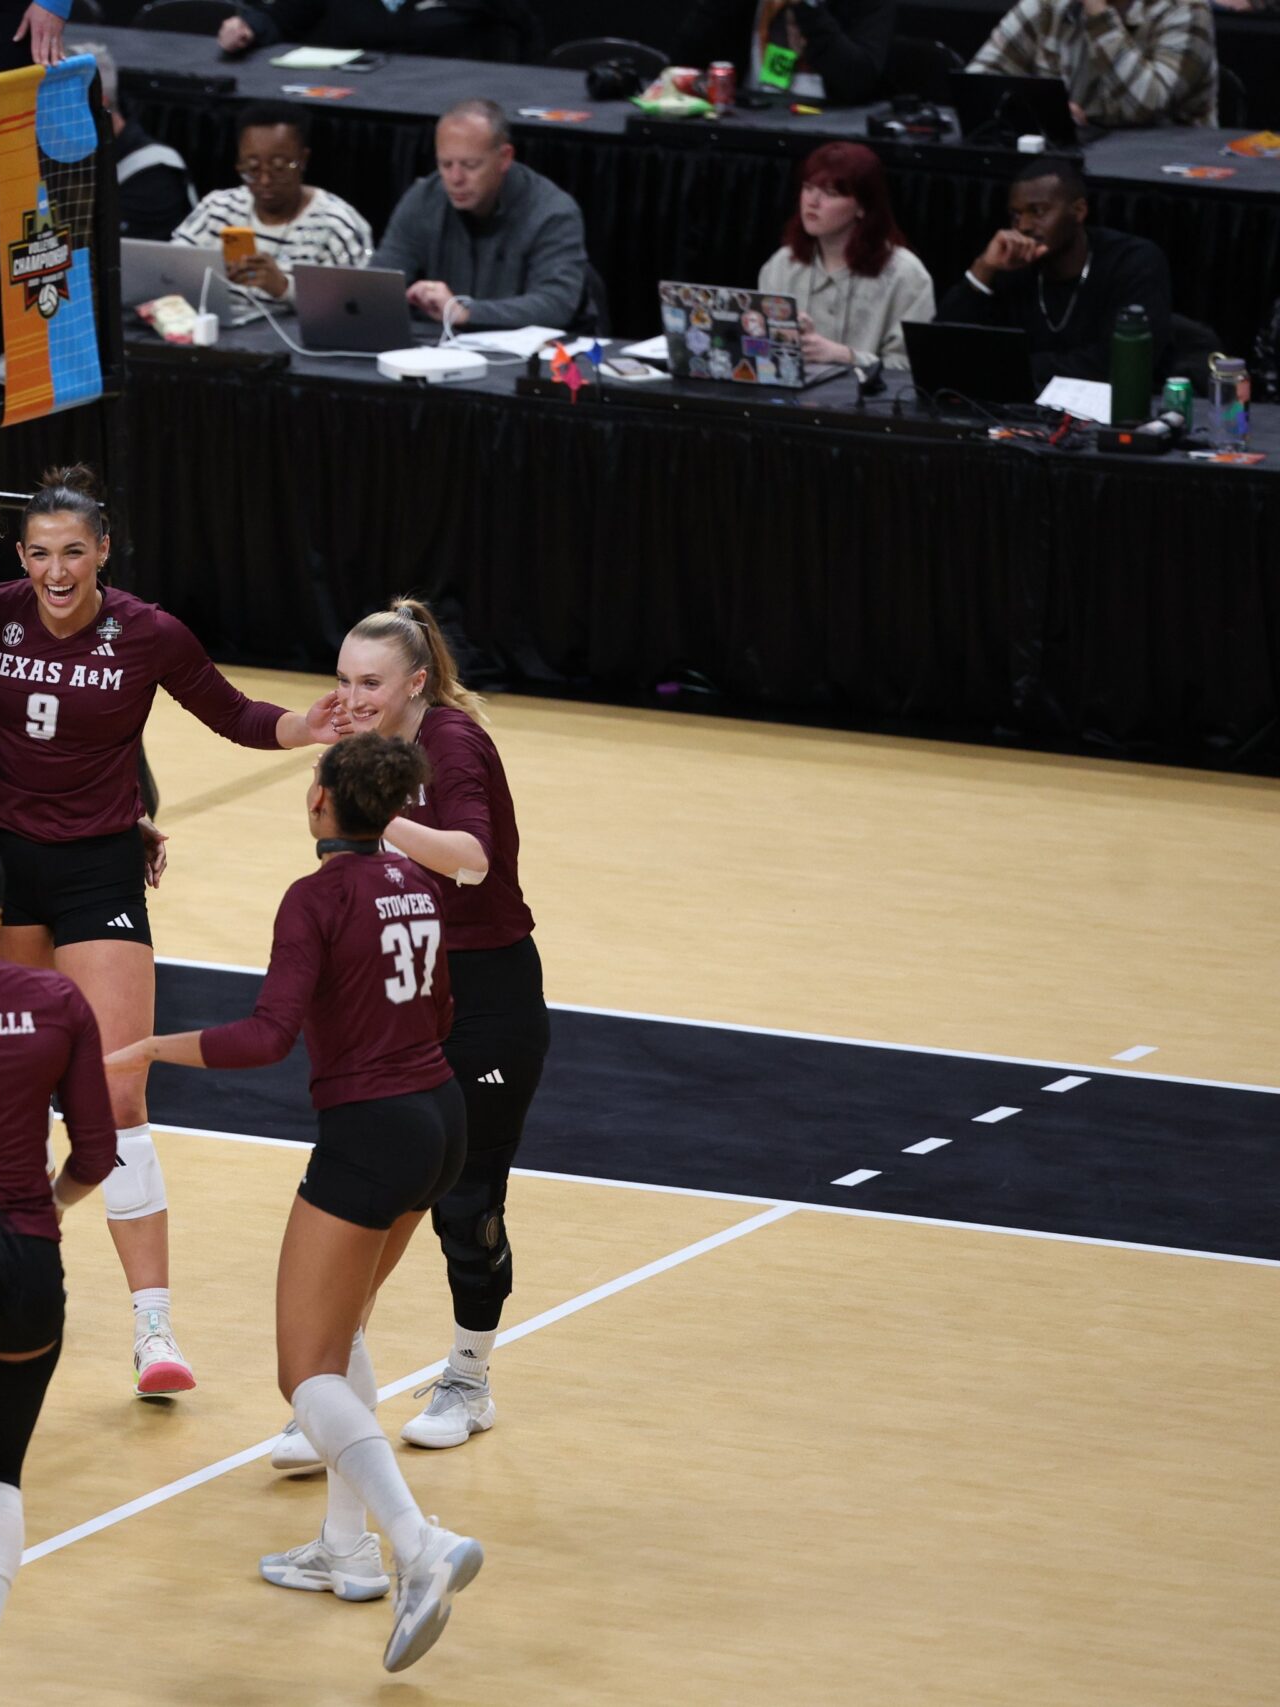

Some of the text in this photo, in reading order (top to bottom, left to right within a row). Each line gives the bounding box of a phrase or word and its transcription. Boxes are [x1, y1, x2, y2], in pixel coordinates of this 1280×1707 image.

[4, 623, 23, 645] SEC
[69, 665, 123, 690] A&M
[25, 693, 60, 741] 9
[375, 893, 435, 919] STOWERS
[380, 920, 441, 1005] 37
